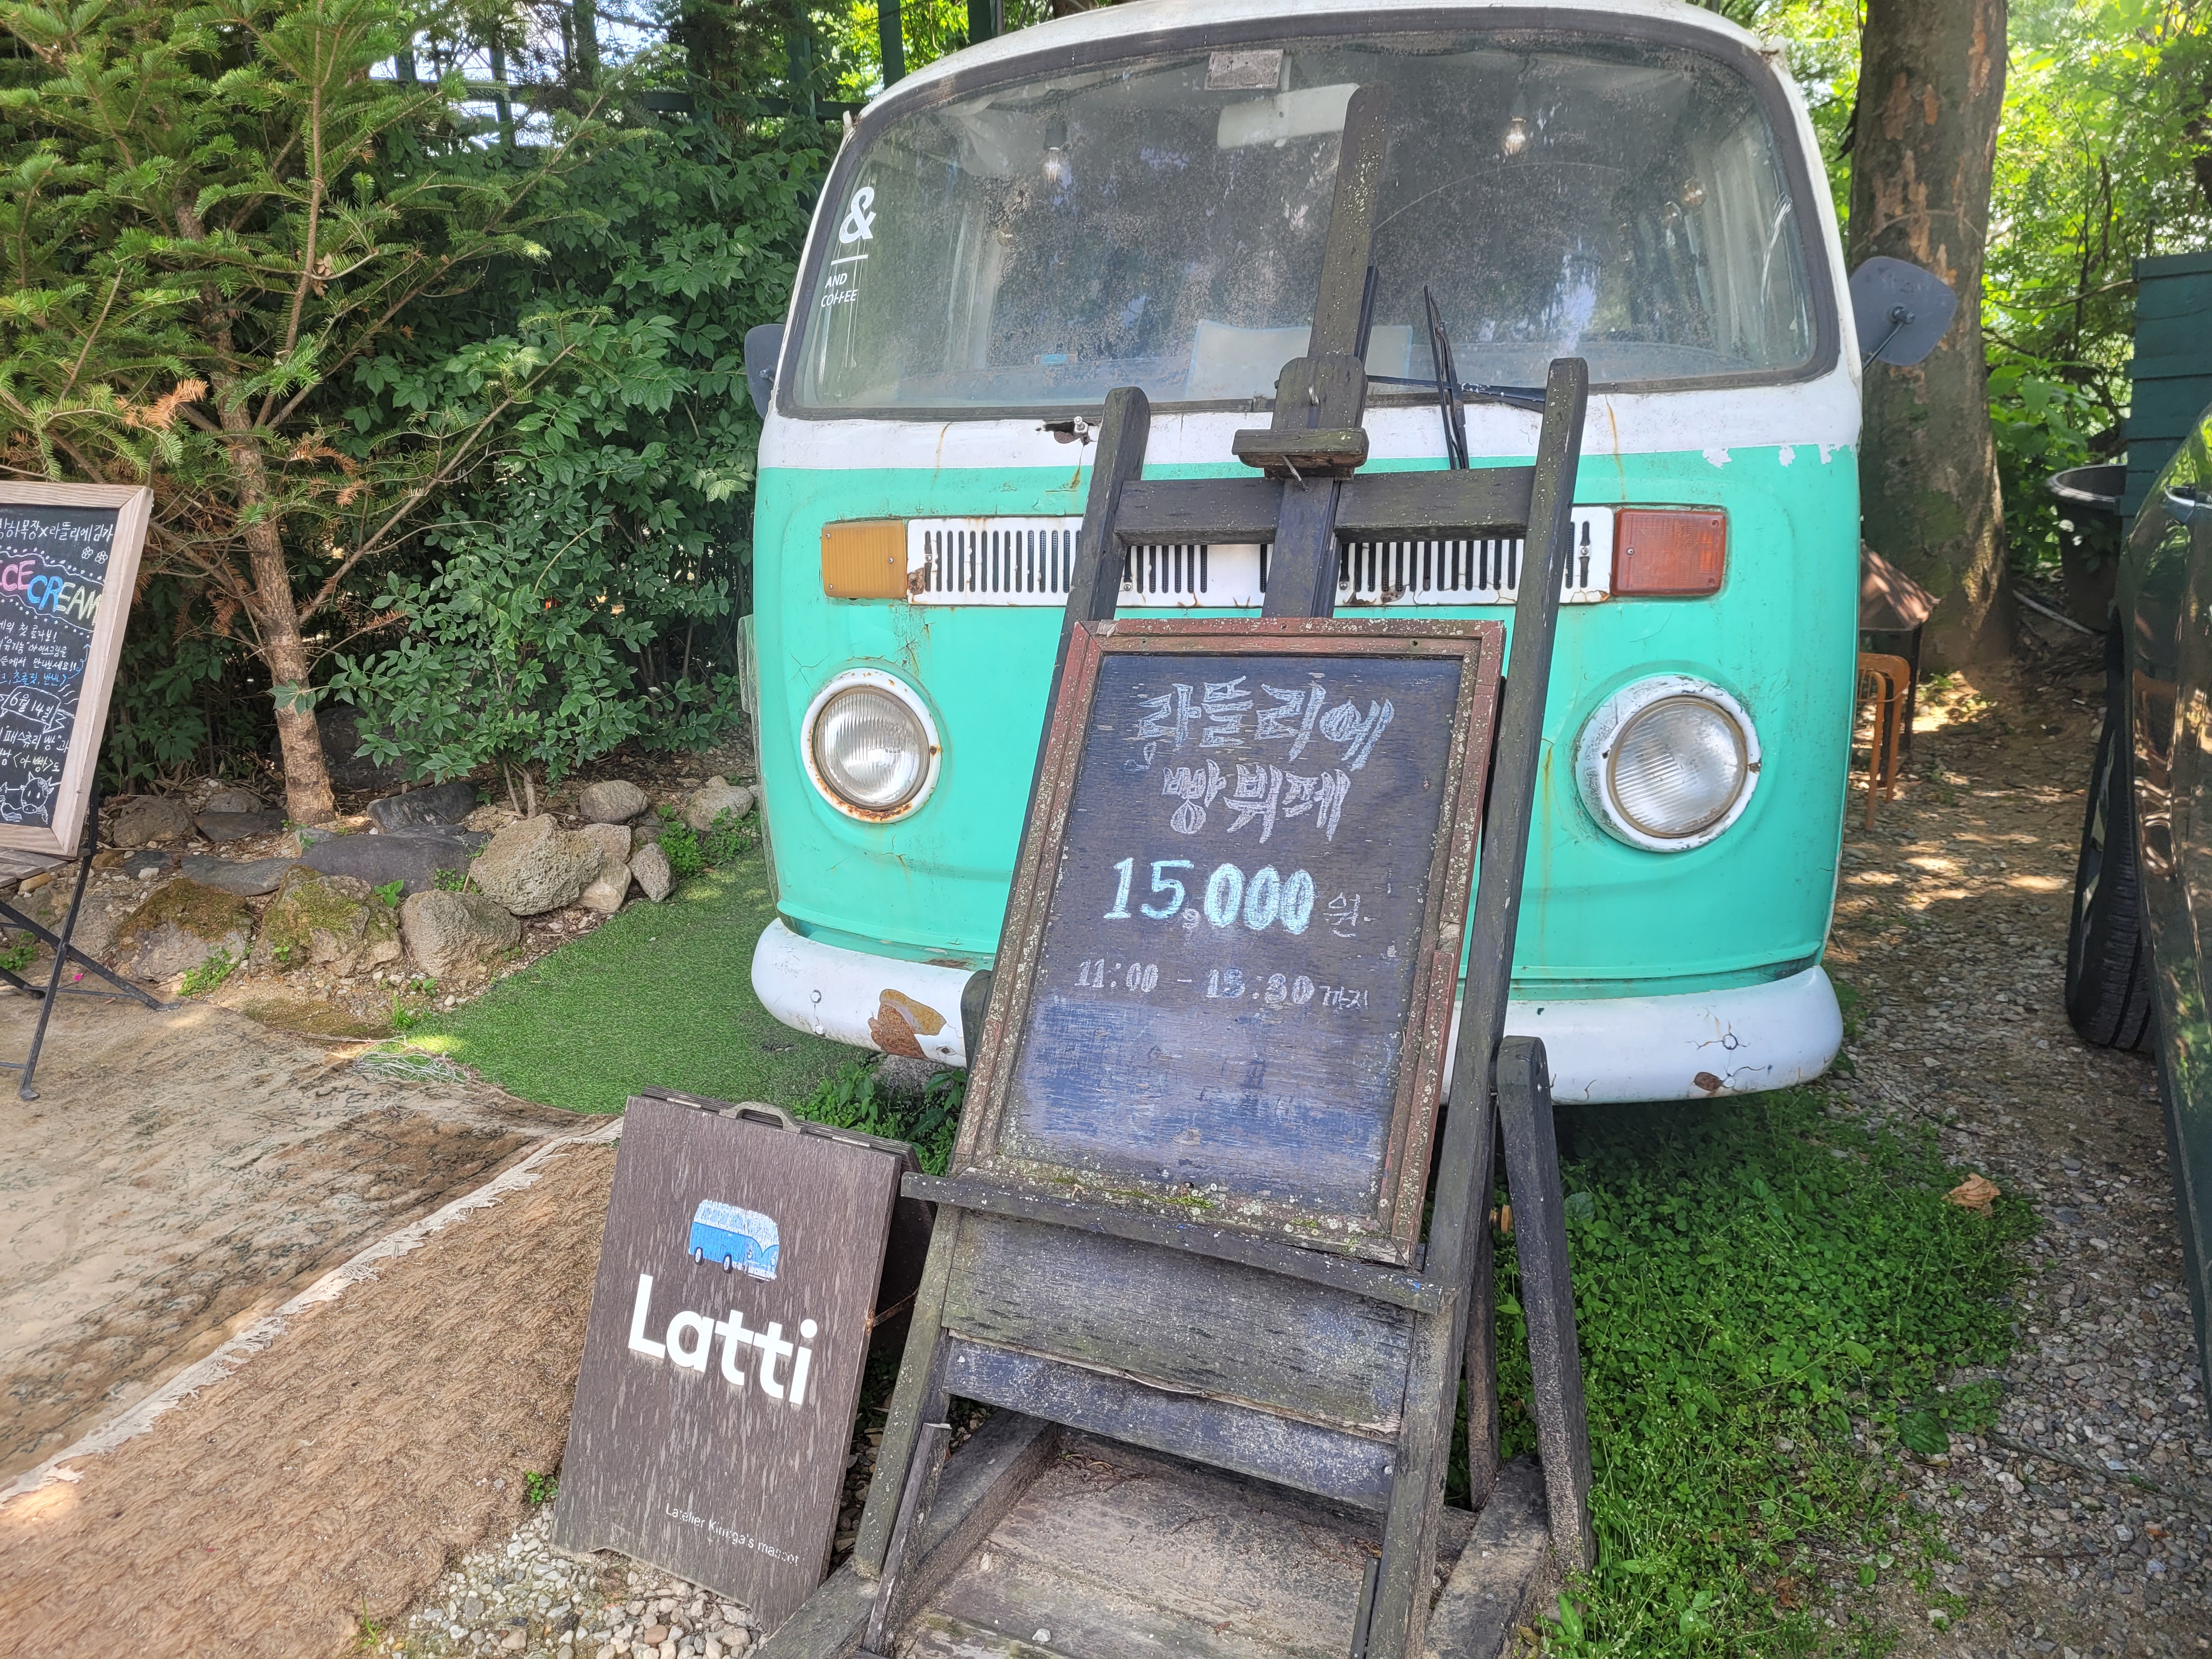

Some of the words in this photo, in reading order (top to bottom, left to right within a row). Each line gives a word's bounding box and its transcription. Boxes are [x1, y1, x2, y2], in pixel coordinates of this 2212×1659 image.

[825, 273, 848, 289] AND
[821, 289, 859, 308] COFFEE
[27, 575, 101, 625] CREAM
[19, 622, 29, 636] 첫
[33, 658, 77, 672] 만나보세요!!
[1161, 759, 1351, 844] 빵뷔페
[1074, 958, 1159, 992] 11:00
[628, 1273, 819, 1406] Latti
